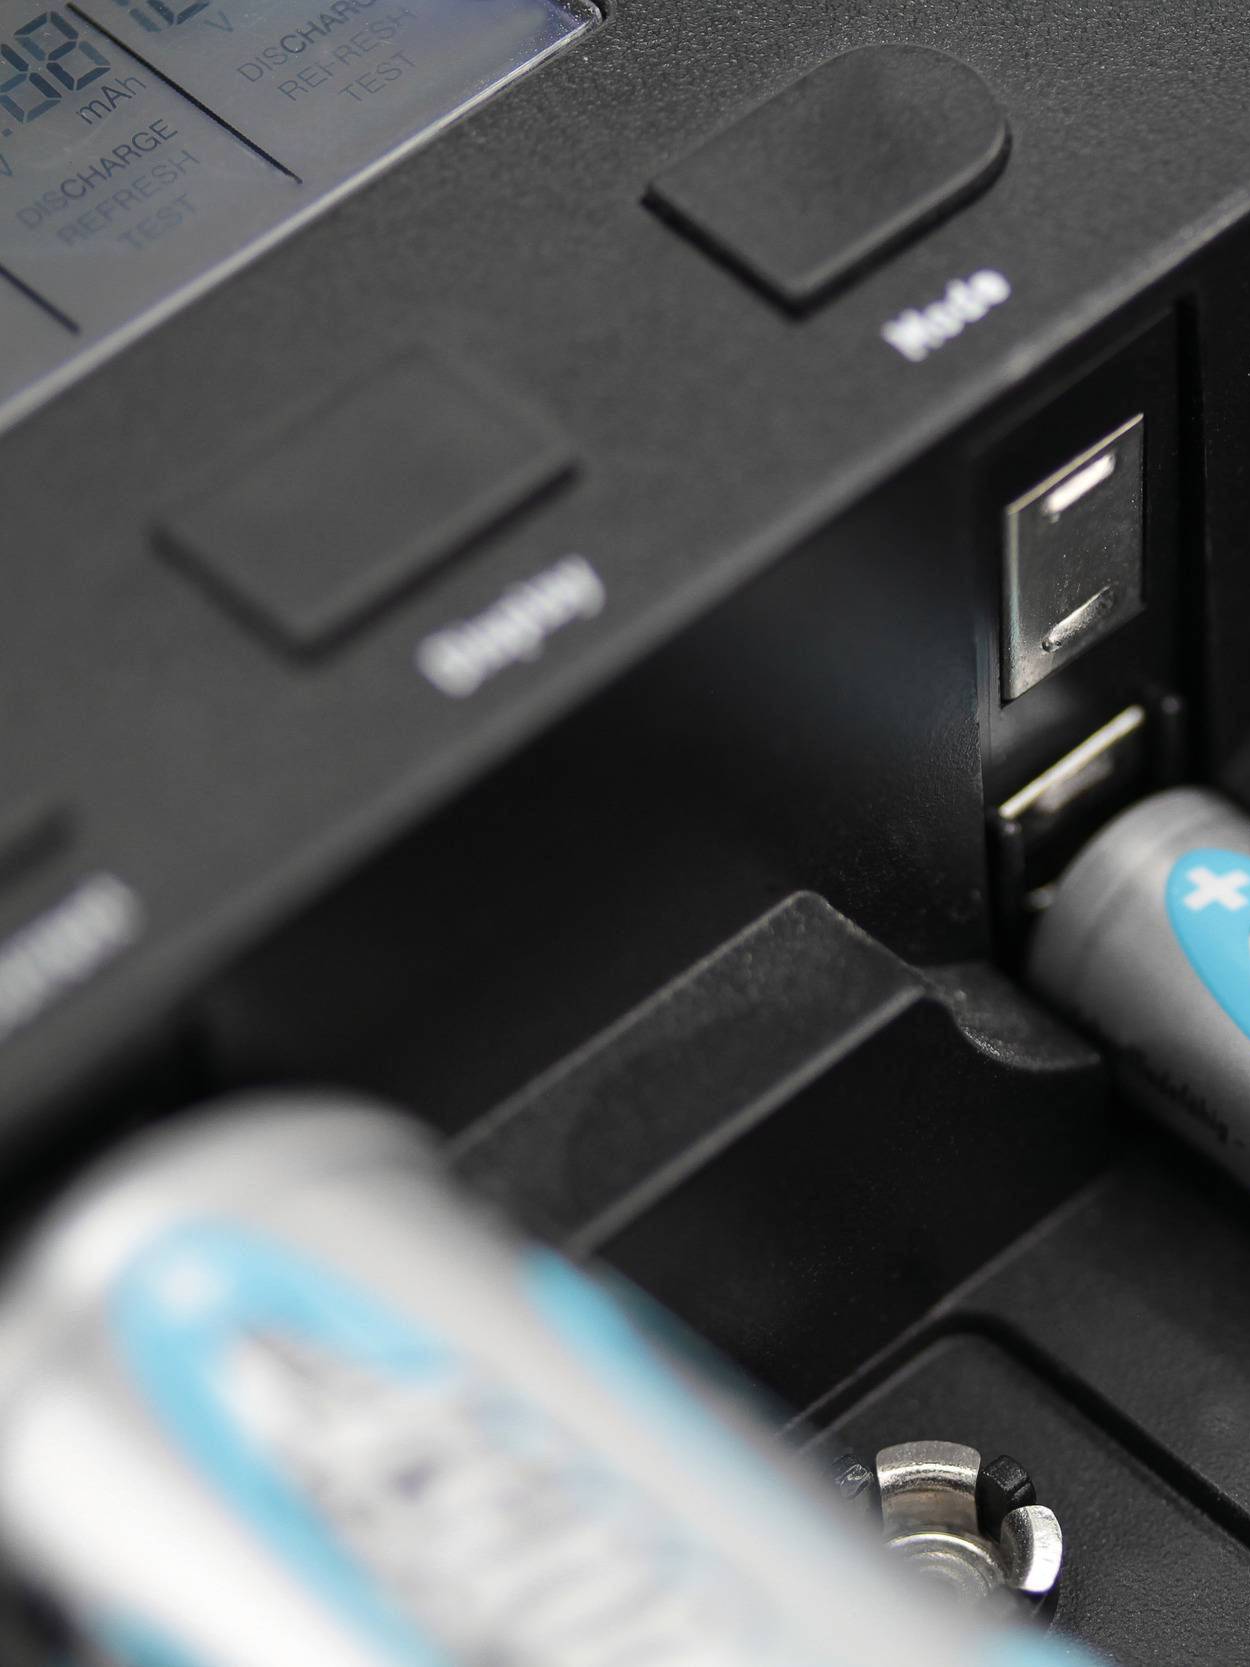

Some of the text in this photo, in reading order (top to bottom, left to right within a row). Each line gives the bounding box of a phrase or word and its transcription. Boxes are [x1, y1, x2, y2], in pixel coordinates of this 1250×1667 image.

[75, 74, 147, 125] mAh
[338, 49, 417, 102] TEST
[16, 118, 179, 230] DISCHARGE
[56, 149, 201, 246] REFRESH
